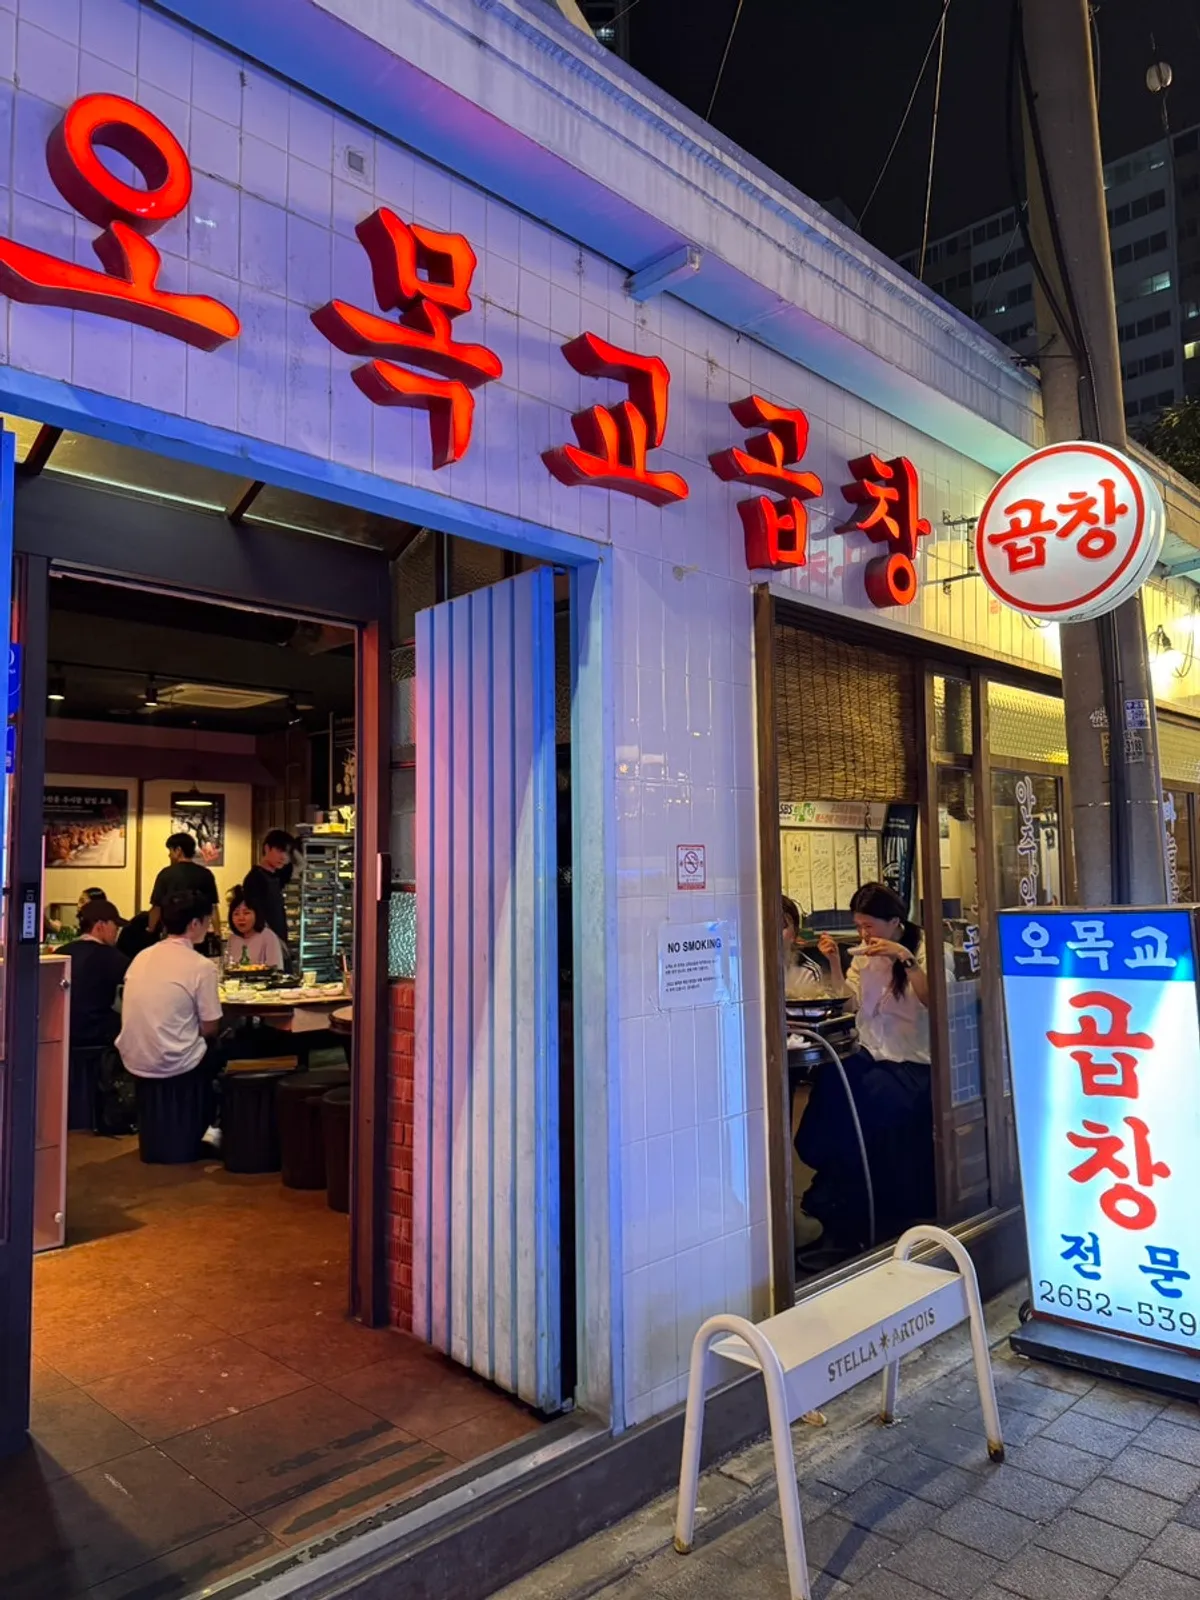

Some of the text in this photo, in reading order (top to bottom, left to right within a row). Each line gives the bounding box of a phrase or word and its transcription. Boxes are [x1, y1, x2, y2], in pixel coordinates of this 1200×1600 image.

[987, 478, 1129, 576] 곱창
[667, 937, 722, 954] NO SMOKING
[1014, 920, 1178, 972] 오목교
[1045, 990, 1172, 1231] 곱창
[1060, 1232, 1191, 1298] 전문
[827, 1307, 936, 1382] STELLA ARTOIS
